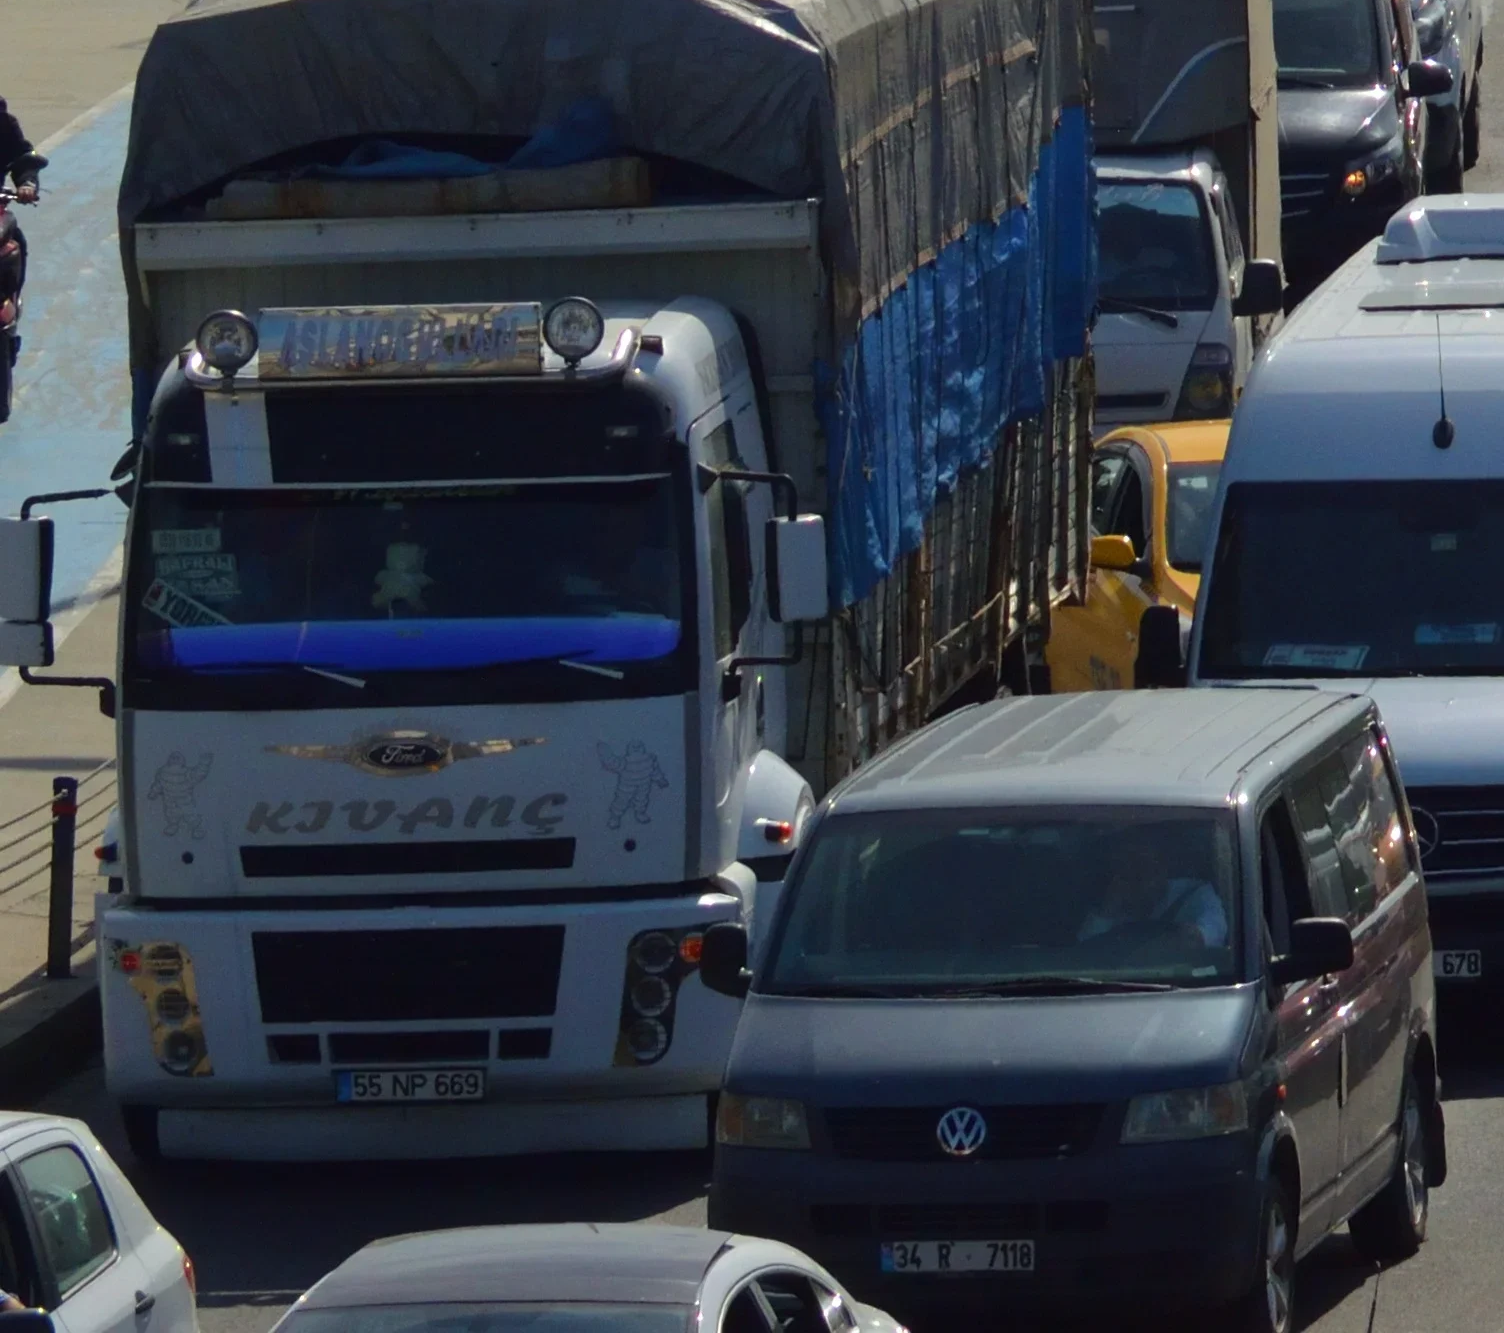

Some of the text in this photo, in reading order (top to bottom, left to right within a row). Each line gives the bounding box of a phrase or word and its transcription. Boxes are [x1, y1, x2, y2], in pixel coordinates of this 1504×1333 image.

[381, 744, 426, 765] Ford
[1443, 953, 1479, 974] 678
[353, 1073, 478, 1097] 55 NP 669
[893, 1243, 922, 1270] 34
[986, 1242, 1032, 1269] 7118
